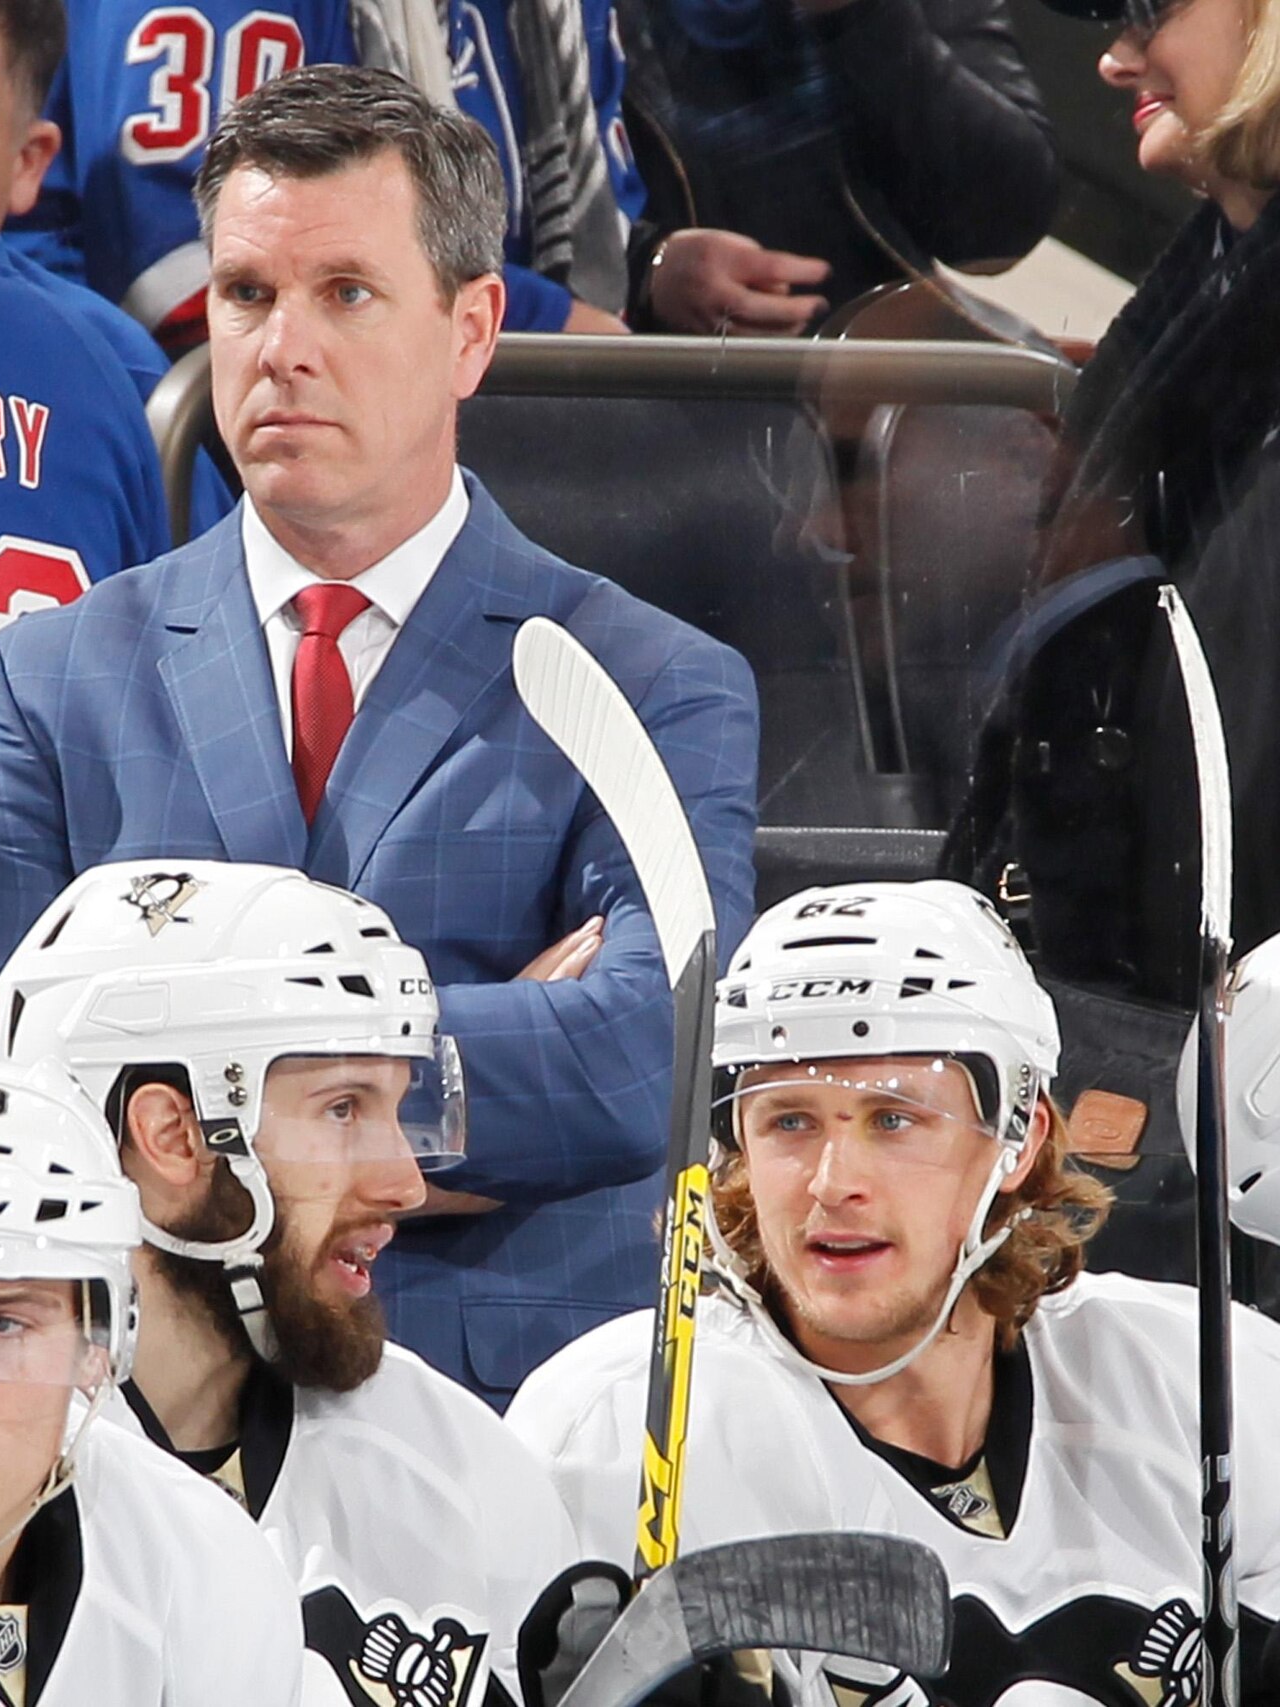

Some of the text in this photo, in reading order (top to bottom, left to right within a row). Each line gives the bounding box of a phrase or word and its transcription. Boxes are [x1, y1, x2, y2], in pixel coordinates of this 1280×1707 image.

[122, 6, 304, 165] 30
[768, 979, 874, 1001] CCM
[680, 1188, 704, 1319] CCM
